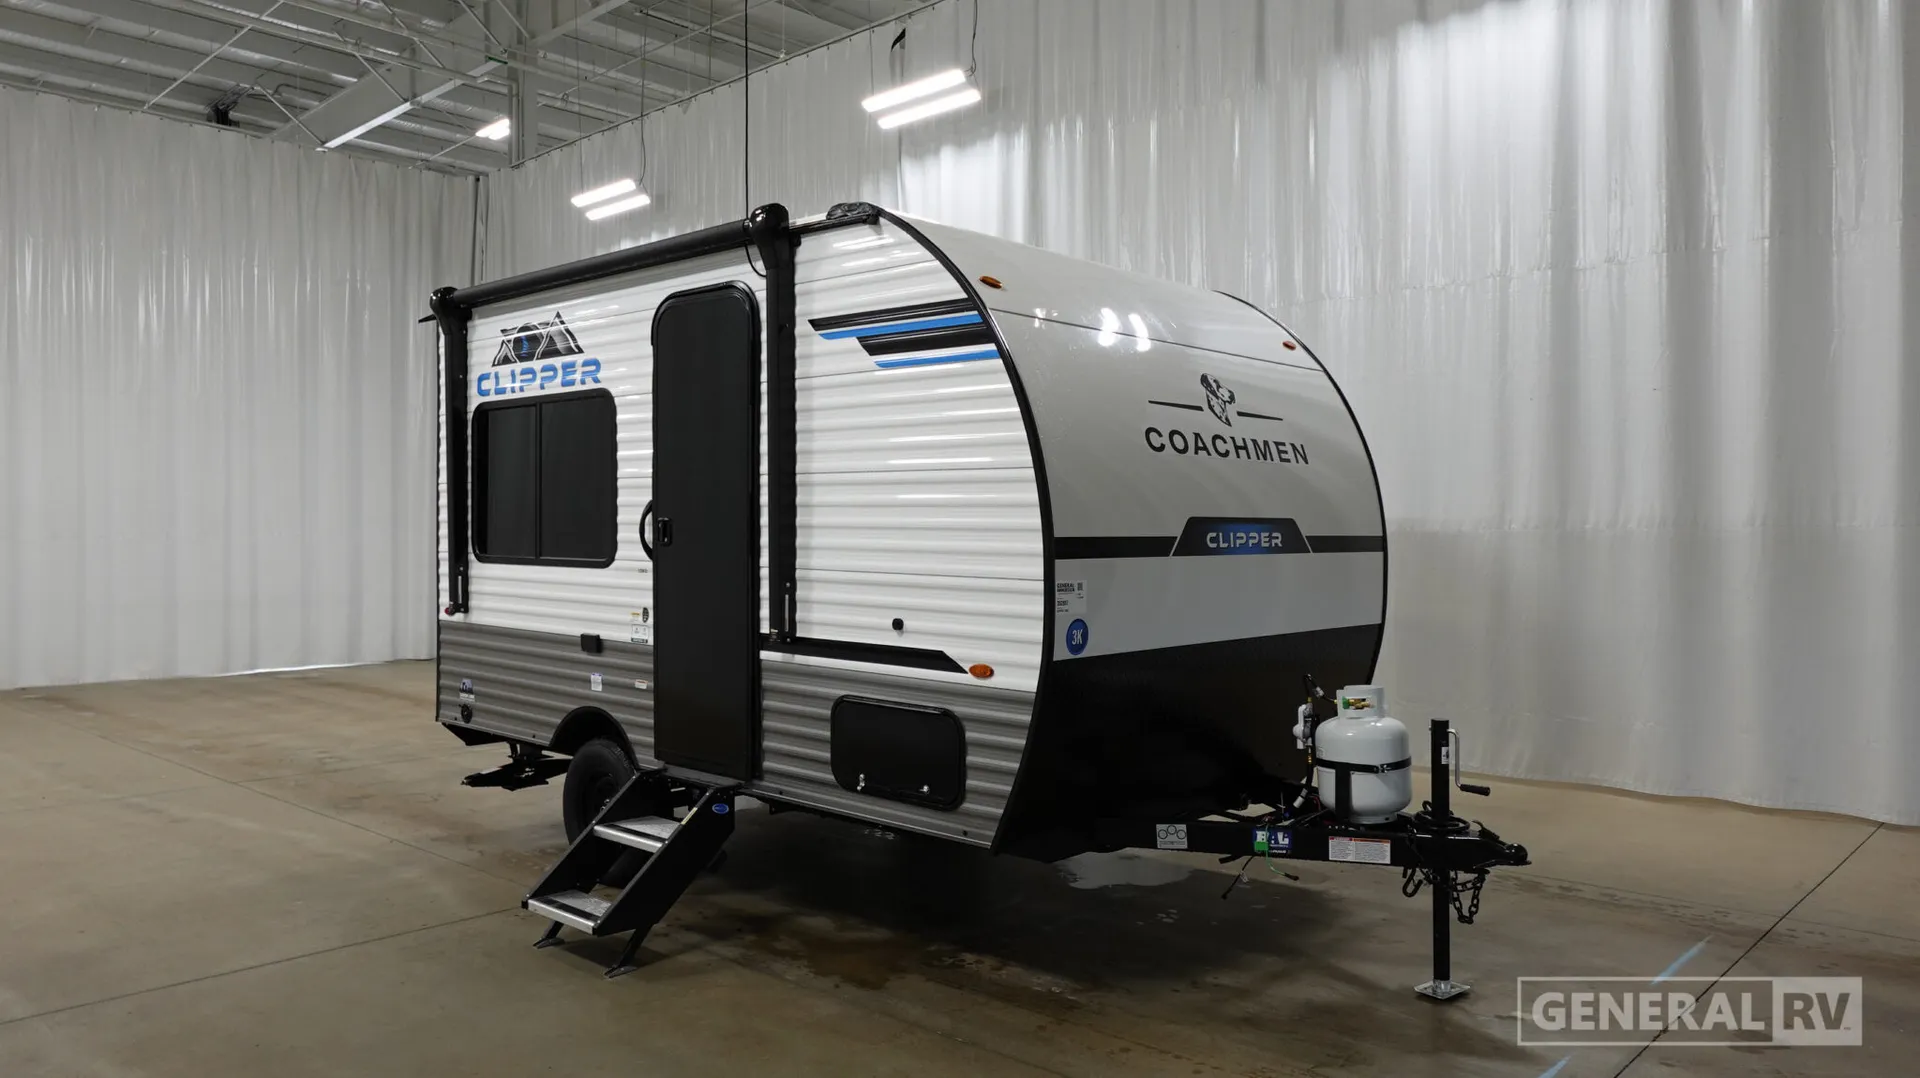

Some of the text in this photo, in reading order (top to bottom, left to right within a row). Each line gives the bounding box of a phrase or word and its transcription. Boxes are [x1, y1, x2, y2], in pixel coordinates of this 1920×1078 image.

[477, 358, 601, 397] CLIPPER
[1145, 427, 1309, 465] COACHMEN
[1206, 532, 1282, 548] CLIPPER
[1071, 630, 1083, 645] 3K
